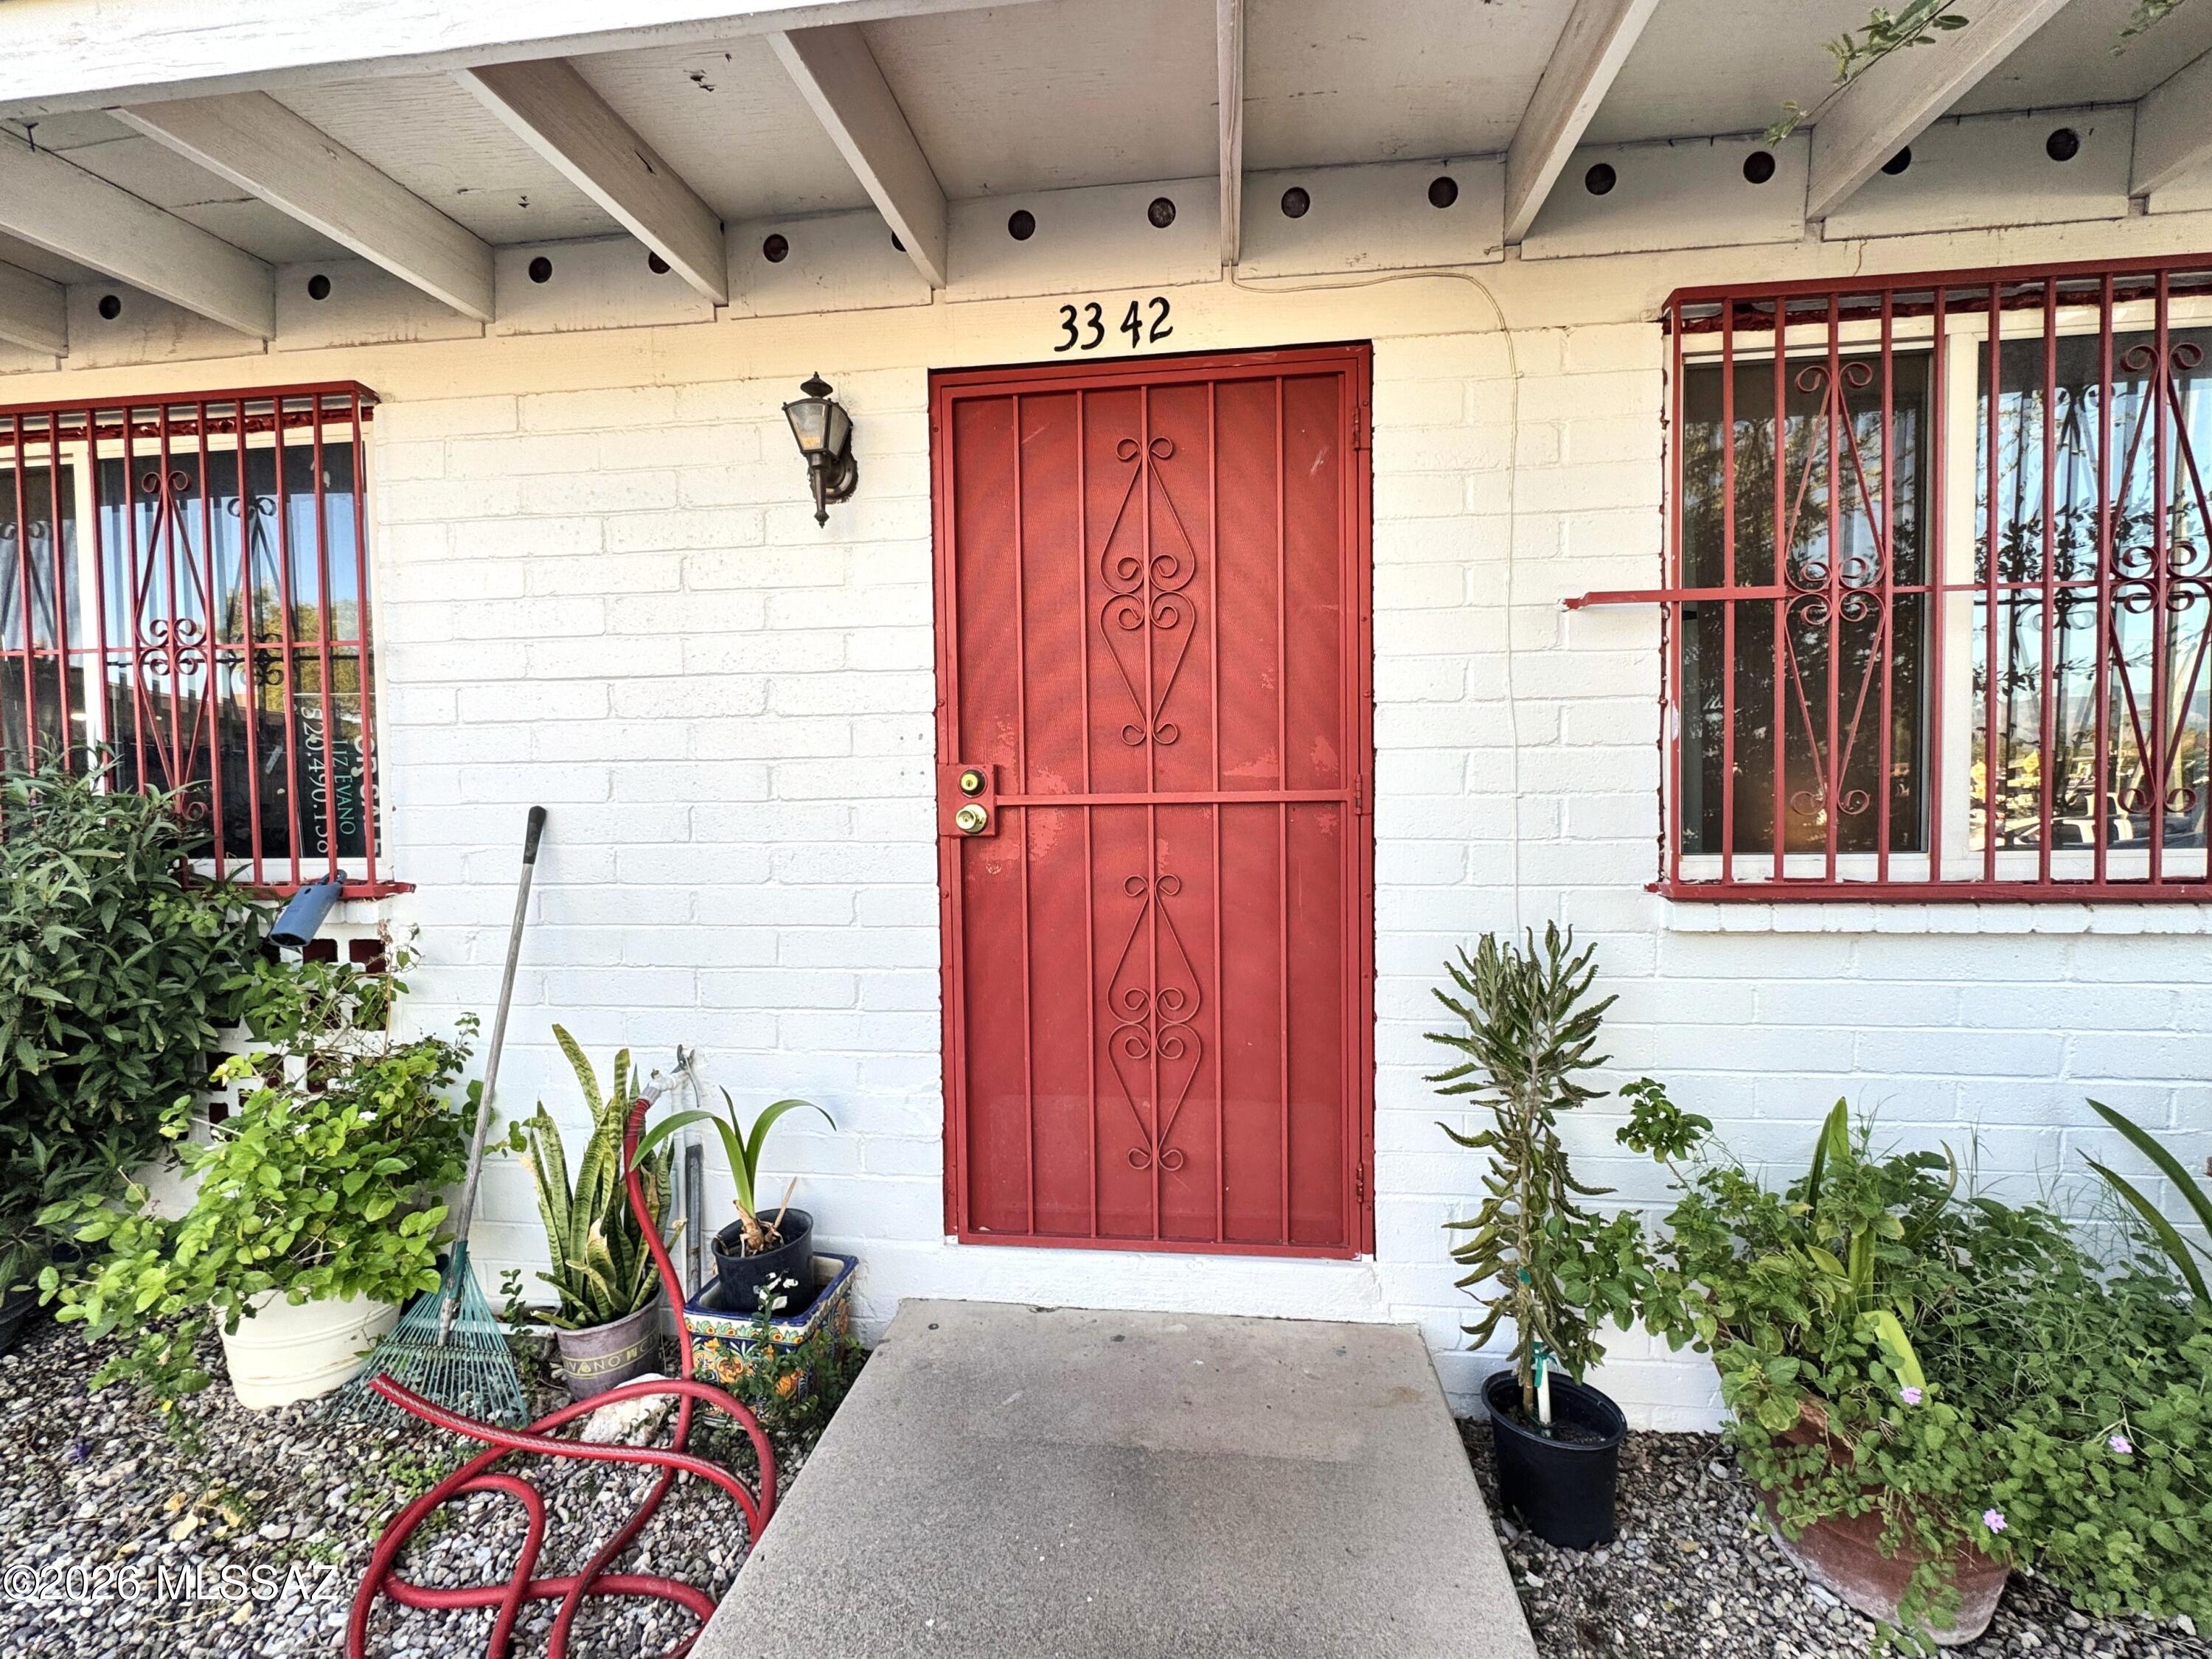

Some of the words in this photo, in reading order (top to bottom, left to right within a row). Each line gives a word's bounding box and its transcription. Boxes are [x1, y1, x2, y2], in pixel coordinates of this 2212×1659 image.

[1054, 296, 1173, 352] 3342
[332, 740, 349, 767] LIZ
[335, 775, 356, 835] EVANO
